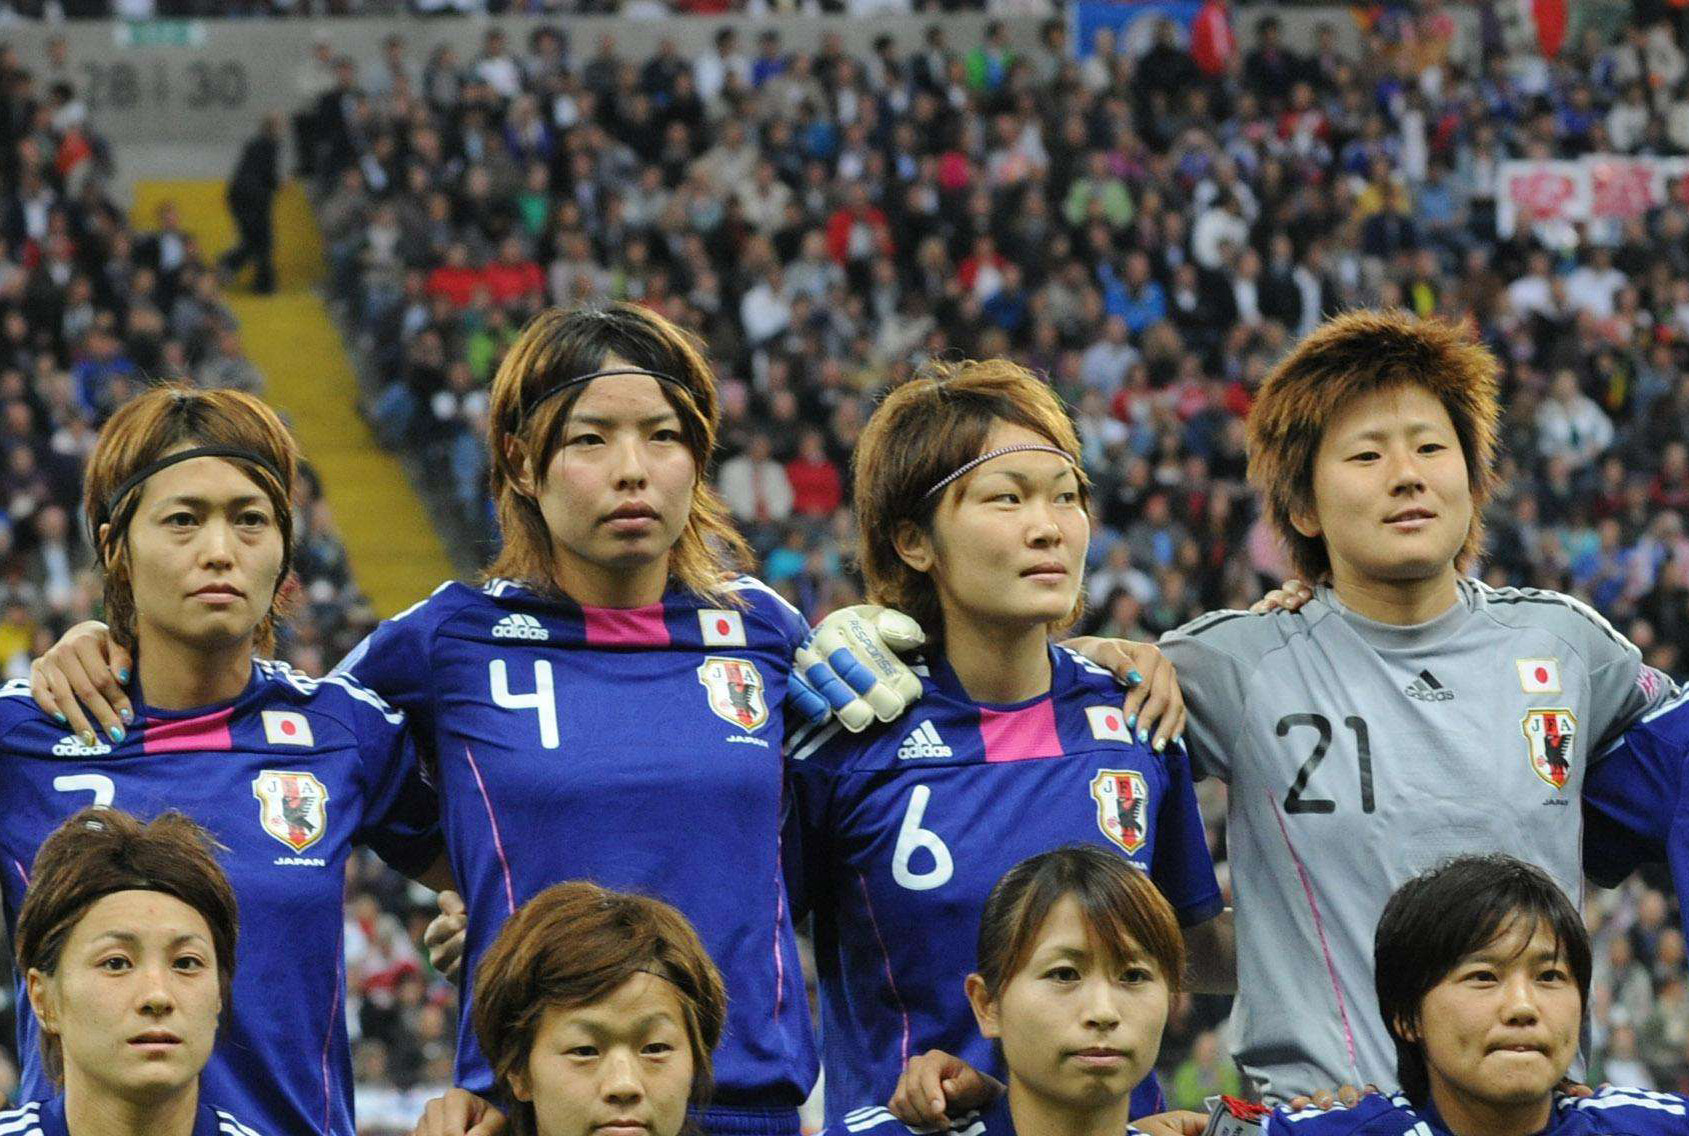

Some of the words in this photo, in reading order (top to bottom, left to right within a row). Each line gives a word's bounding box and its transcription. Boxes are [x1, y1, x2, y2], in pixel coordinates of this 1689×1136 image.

[492, 624, 549, 640] adidas
[489, 659, 559, 749] 4
[52, 744, 112, 756] adidas
[897, 744, 952, 760] adidas
[1276, 712, 1375, 814] 21
[53, 774, 115, 831] 7
[892, 784, 953, 890] 6
[273, 857, 325, 867] JAPAN
